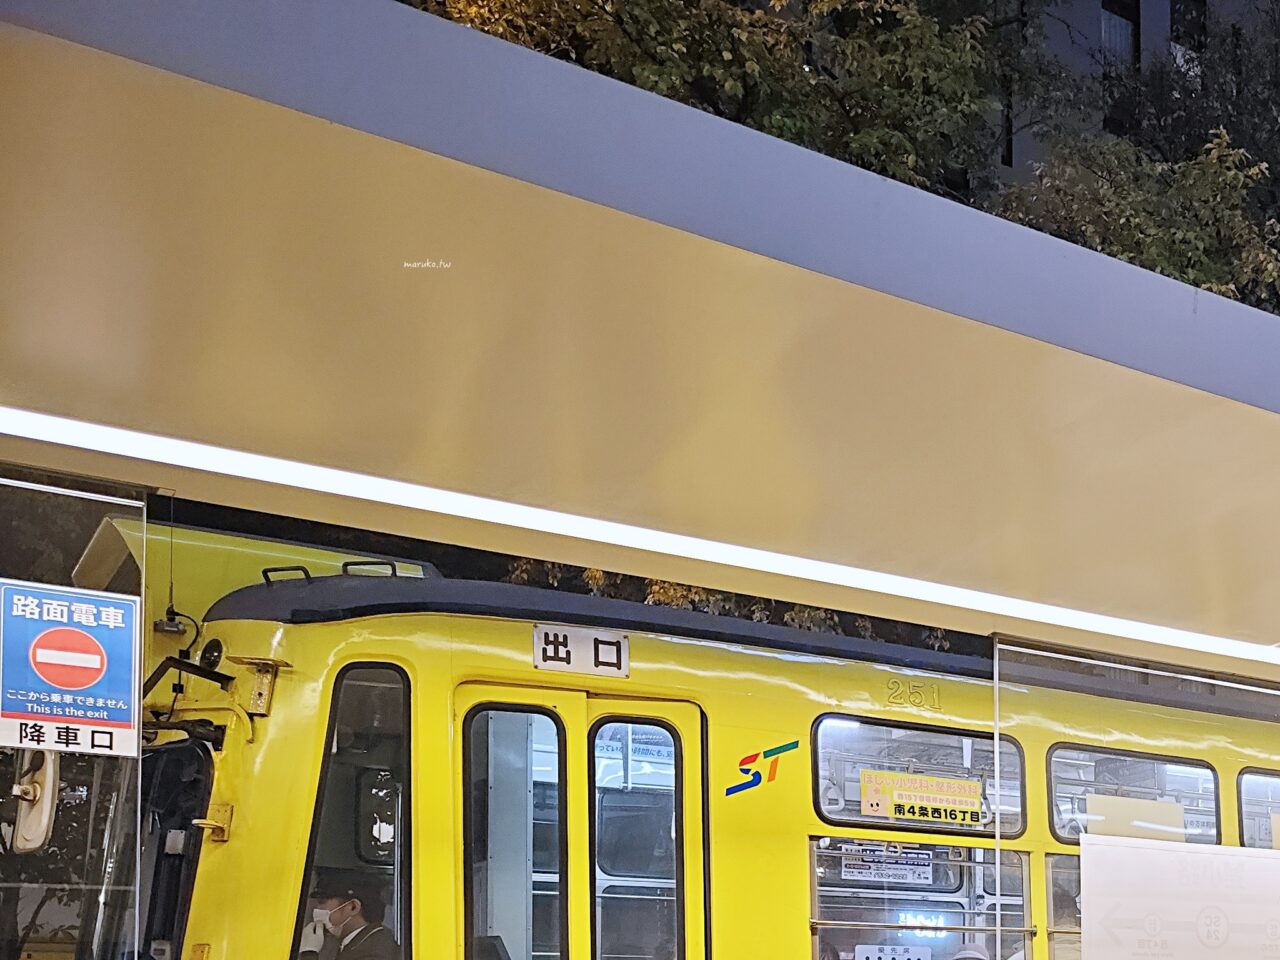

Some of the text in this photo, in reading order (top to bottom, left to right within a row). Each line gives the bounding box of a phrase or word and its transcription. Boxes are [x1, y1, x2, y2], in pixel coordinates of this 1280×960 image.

[11, 594, 126, 629] 路面電車
[541, 631, 622, 671] 出口
[6, 689, 128, 710] ここから乗車できません
[887, 679, 943, 711] 251
[26, 703, 109, 720] This is the exit
[19, 722, 114, 751] 降車口
[893, 804, 980, 823] 南4条西16丁目
